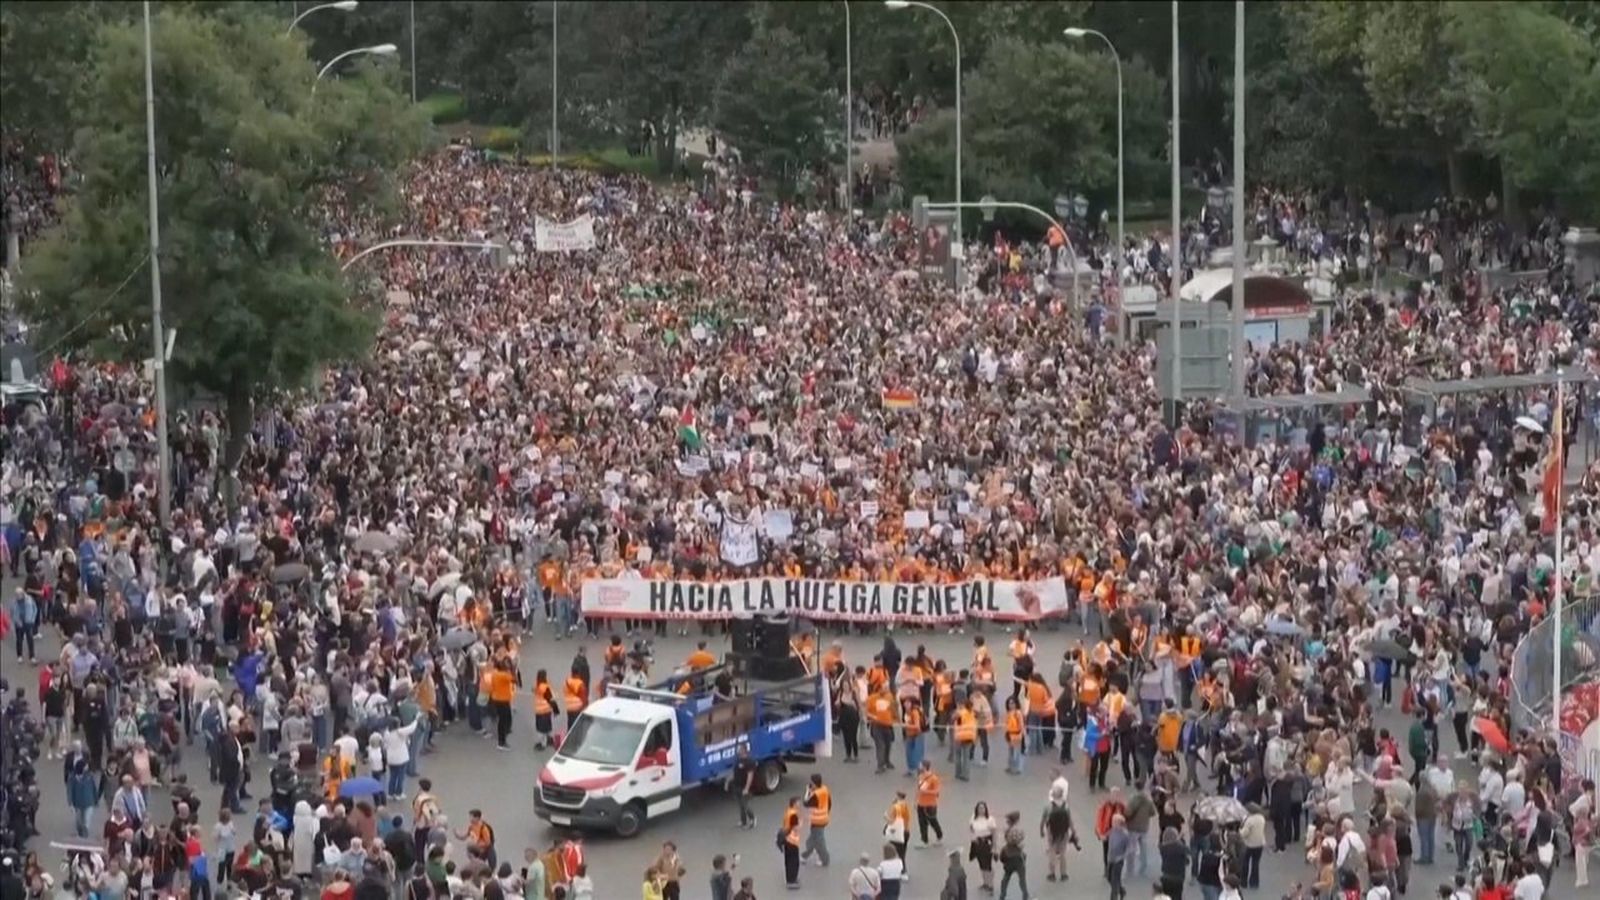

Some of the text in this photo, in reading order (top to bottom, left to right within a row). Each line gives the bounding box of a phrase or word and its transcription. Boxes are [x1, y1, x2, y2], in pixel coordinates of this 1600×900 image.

[650, 581, 734, 612] HACIA
[743, 579, 775, 611] LA
[785, 580, 882, 614] HUELGA
